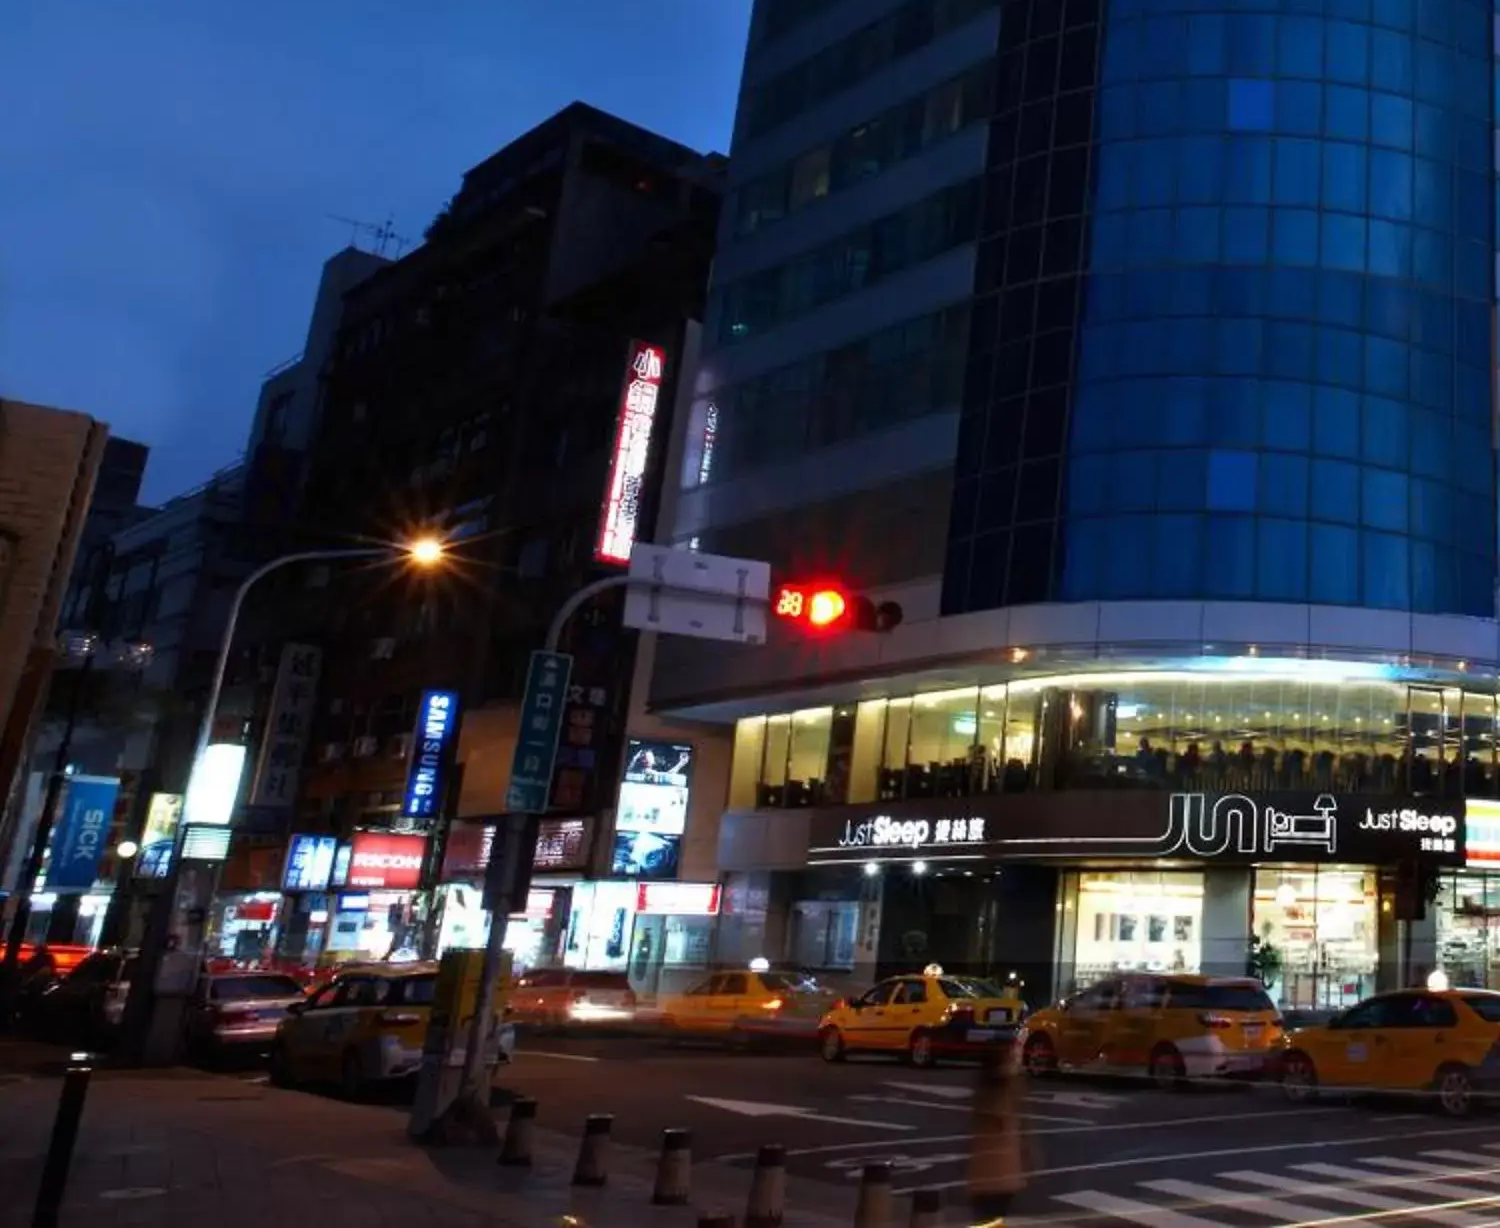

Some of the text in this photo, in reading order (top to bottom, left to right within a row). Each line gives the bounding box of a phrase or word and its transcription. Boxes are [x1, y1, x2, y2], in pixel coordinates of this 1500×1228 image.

[413, 694, 450, 796] SAMSUNG
[73, 807, 104, 862] SICK
[353, 852, 422, 869] RICOH
